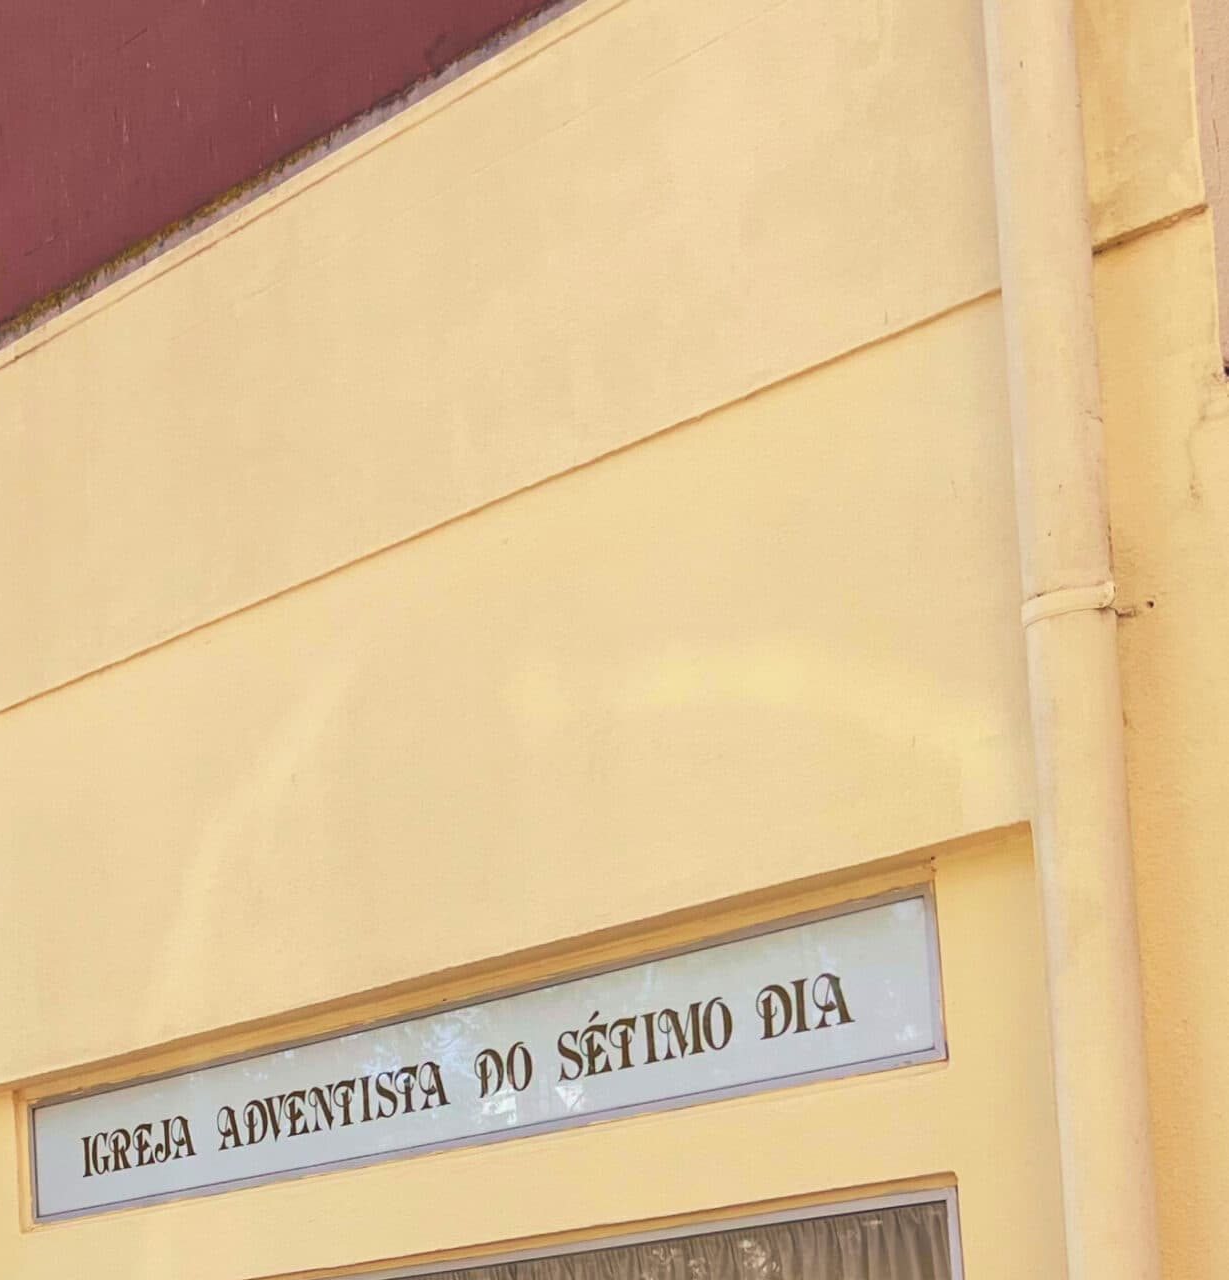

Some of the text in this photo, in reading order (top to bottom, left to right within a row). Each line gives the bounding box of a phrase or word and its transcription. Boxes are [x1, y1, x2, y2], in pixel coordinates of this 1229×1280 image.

[81, 972, 855, 1178] IGREJA ADVENTISTA DO SÉTIMO DIA
